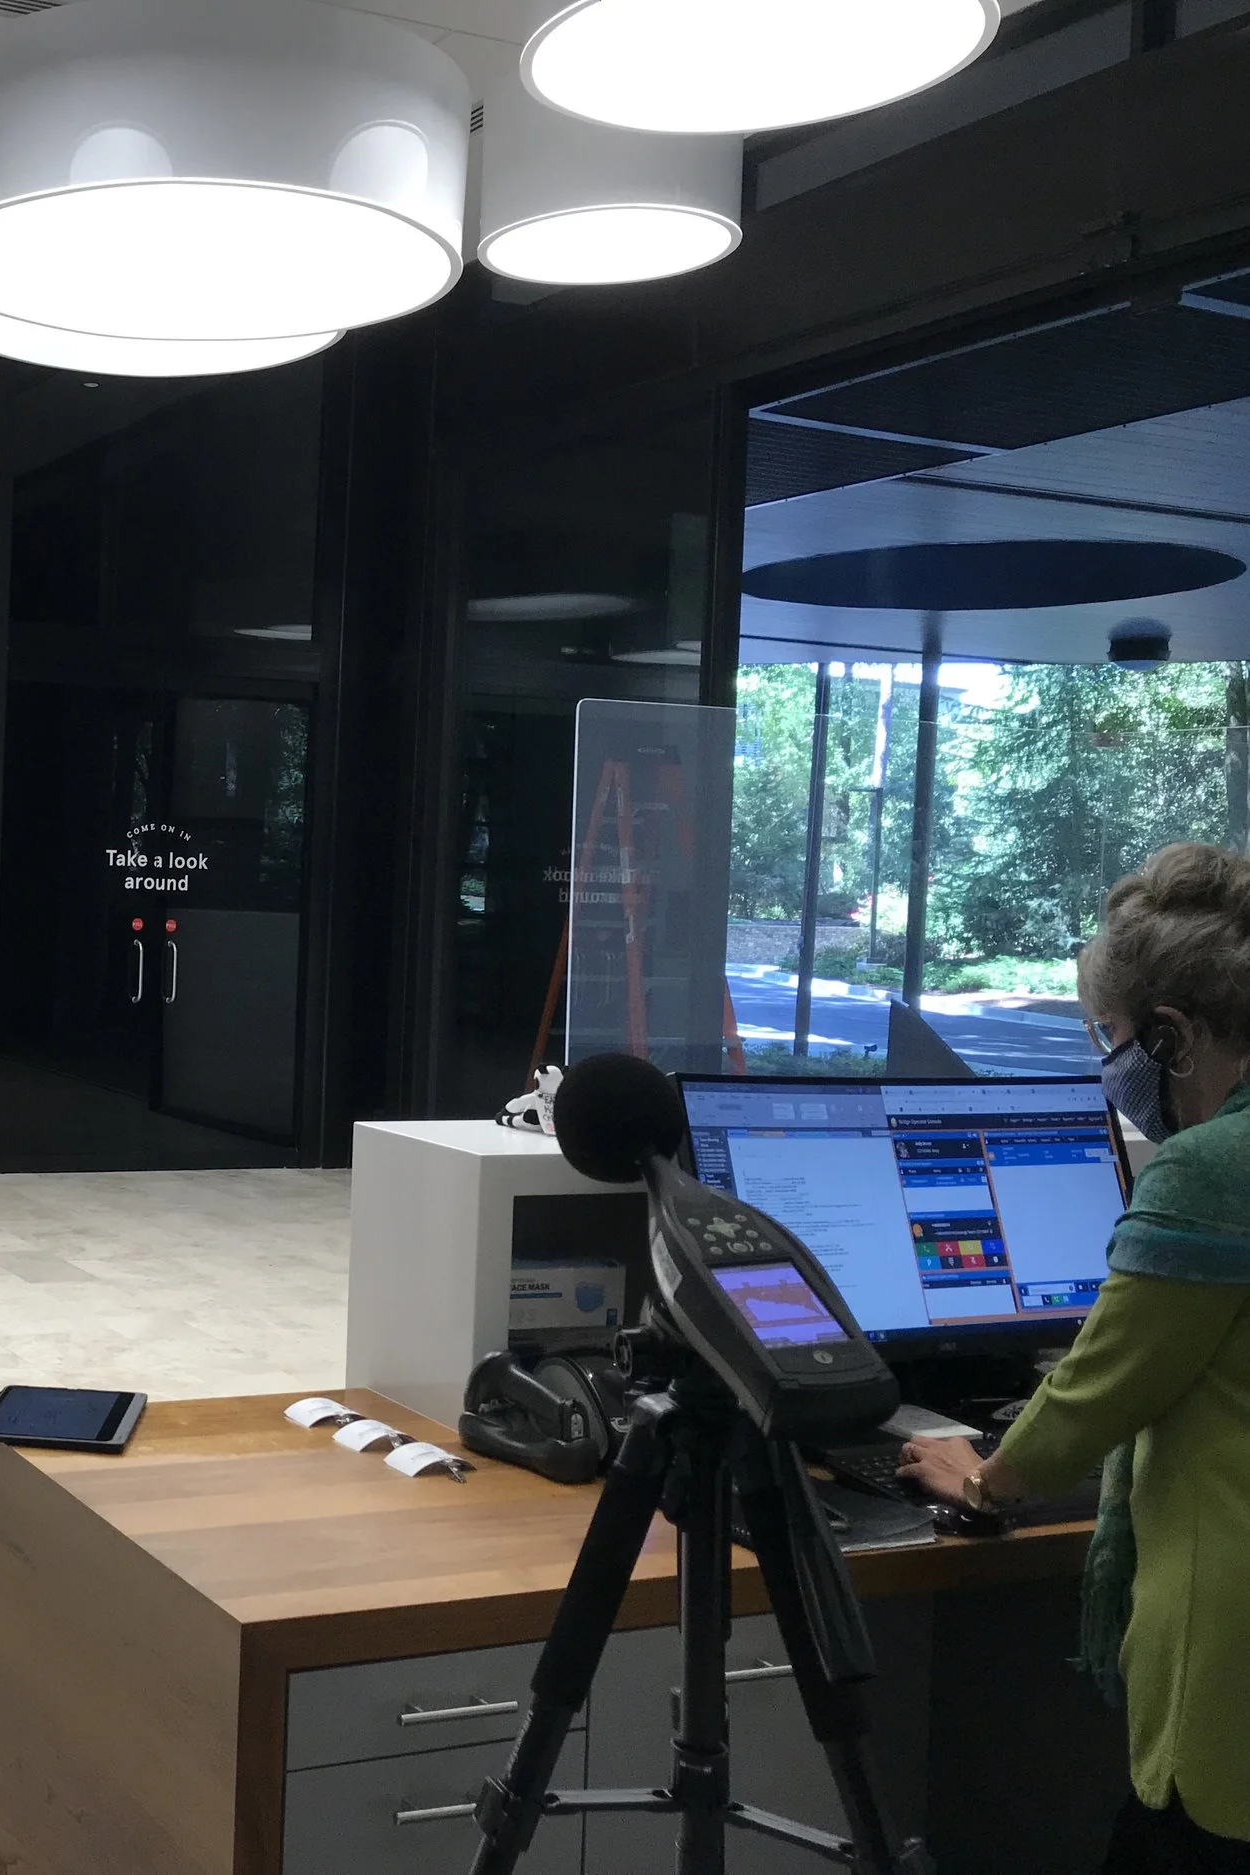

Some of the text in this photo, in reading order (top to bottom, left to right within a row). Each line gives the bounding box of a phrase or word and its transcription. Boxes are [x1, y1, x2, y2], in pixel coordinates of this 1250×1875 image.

[126, 823, 192, 842] COME ON IN
[105, 849, 209, 870] Take a look
[124, 874, 189, 891] around
[510, 1282, 550, 1291] ACE MASK
